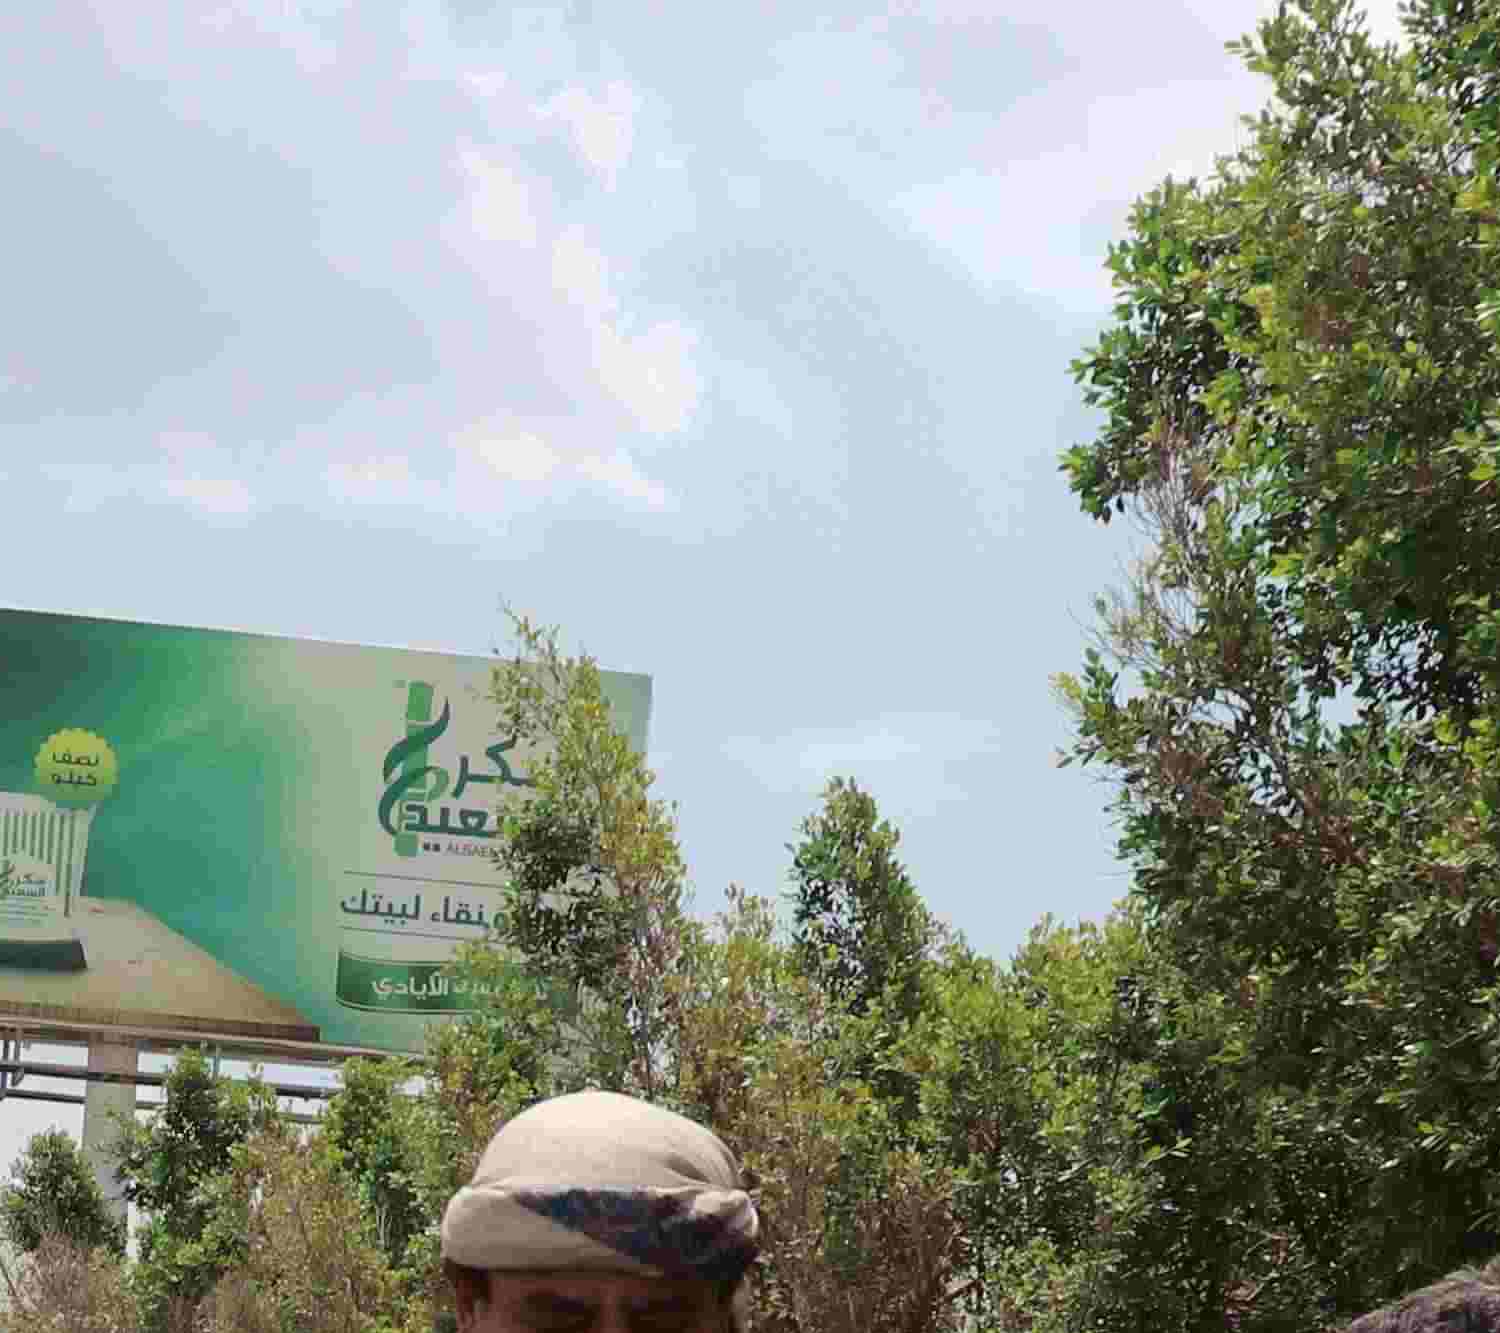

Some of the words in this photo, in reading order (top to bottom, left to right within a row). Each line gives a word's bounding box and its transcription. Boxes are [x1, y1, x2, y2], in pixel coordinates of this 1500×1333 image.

[52, 748, 99, 767] نصف
[51, 769, 97, 790] كيلو
[341, 888, 421, 926] لبيتك
[370, 971, 449, 1001] الأيادي
